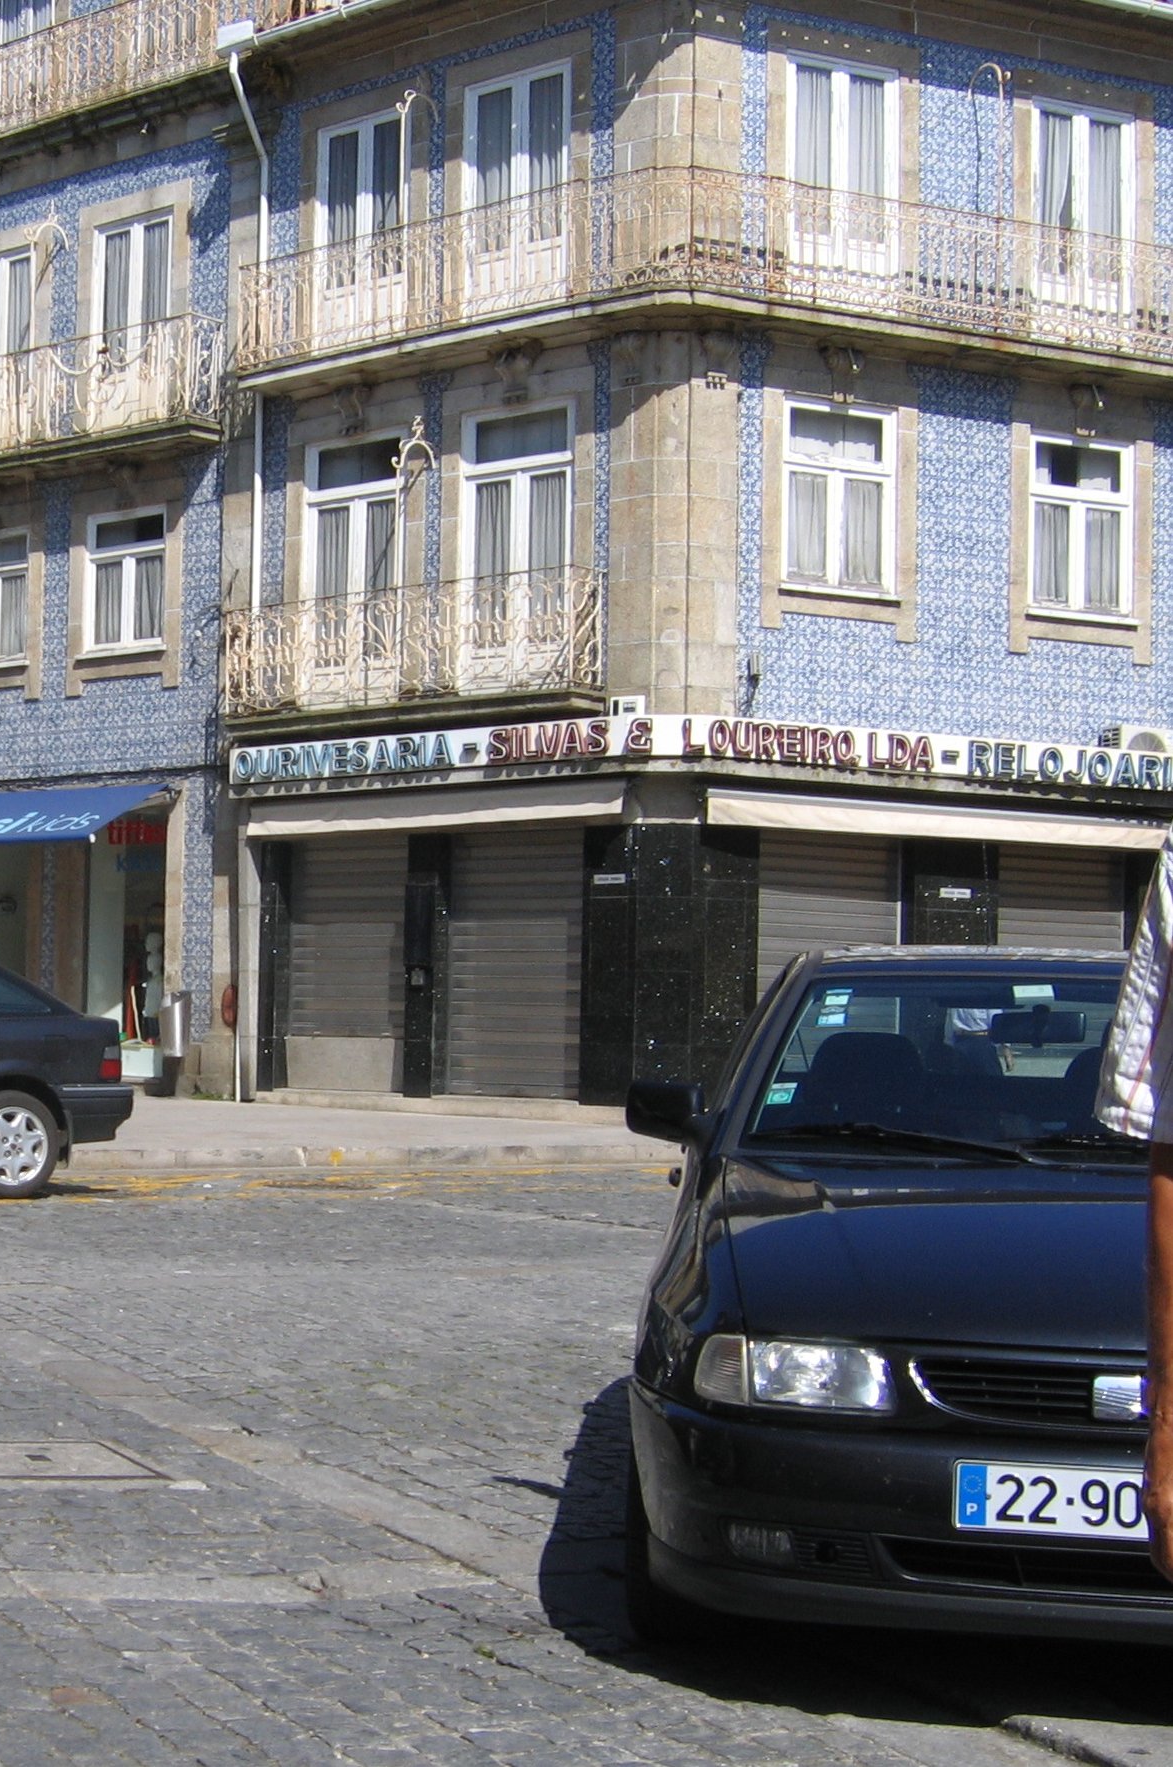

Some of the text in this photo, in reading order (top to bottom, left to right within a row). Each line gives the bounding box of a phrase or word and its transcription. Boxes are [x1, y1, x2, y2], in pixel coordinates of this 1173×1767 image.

[234, 732, 454, 780] OURIVESARIA
[487, 719, 609, 764] SILVAS
[626, 717, 653, 754] &
[868, 731, 934, 770] LDA
[17, 811, 100, 833] kids
[965, 1502, 978, 1516] P
